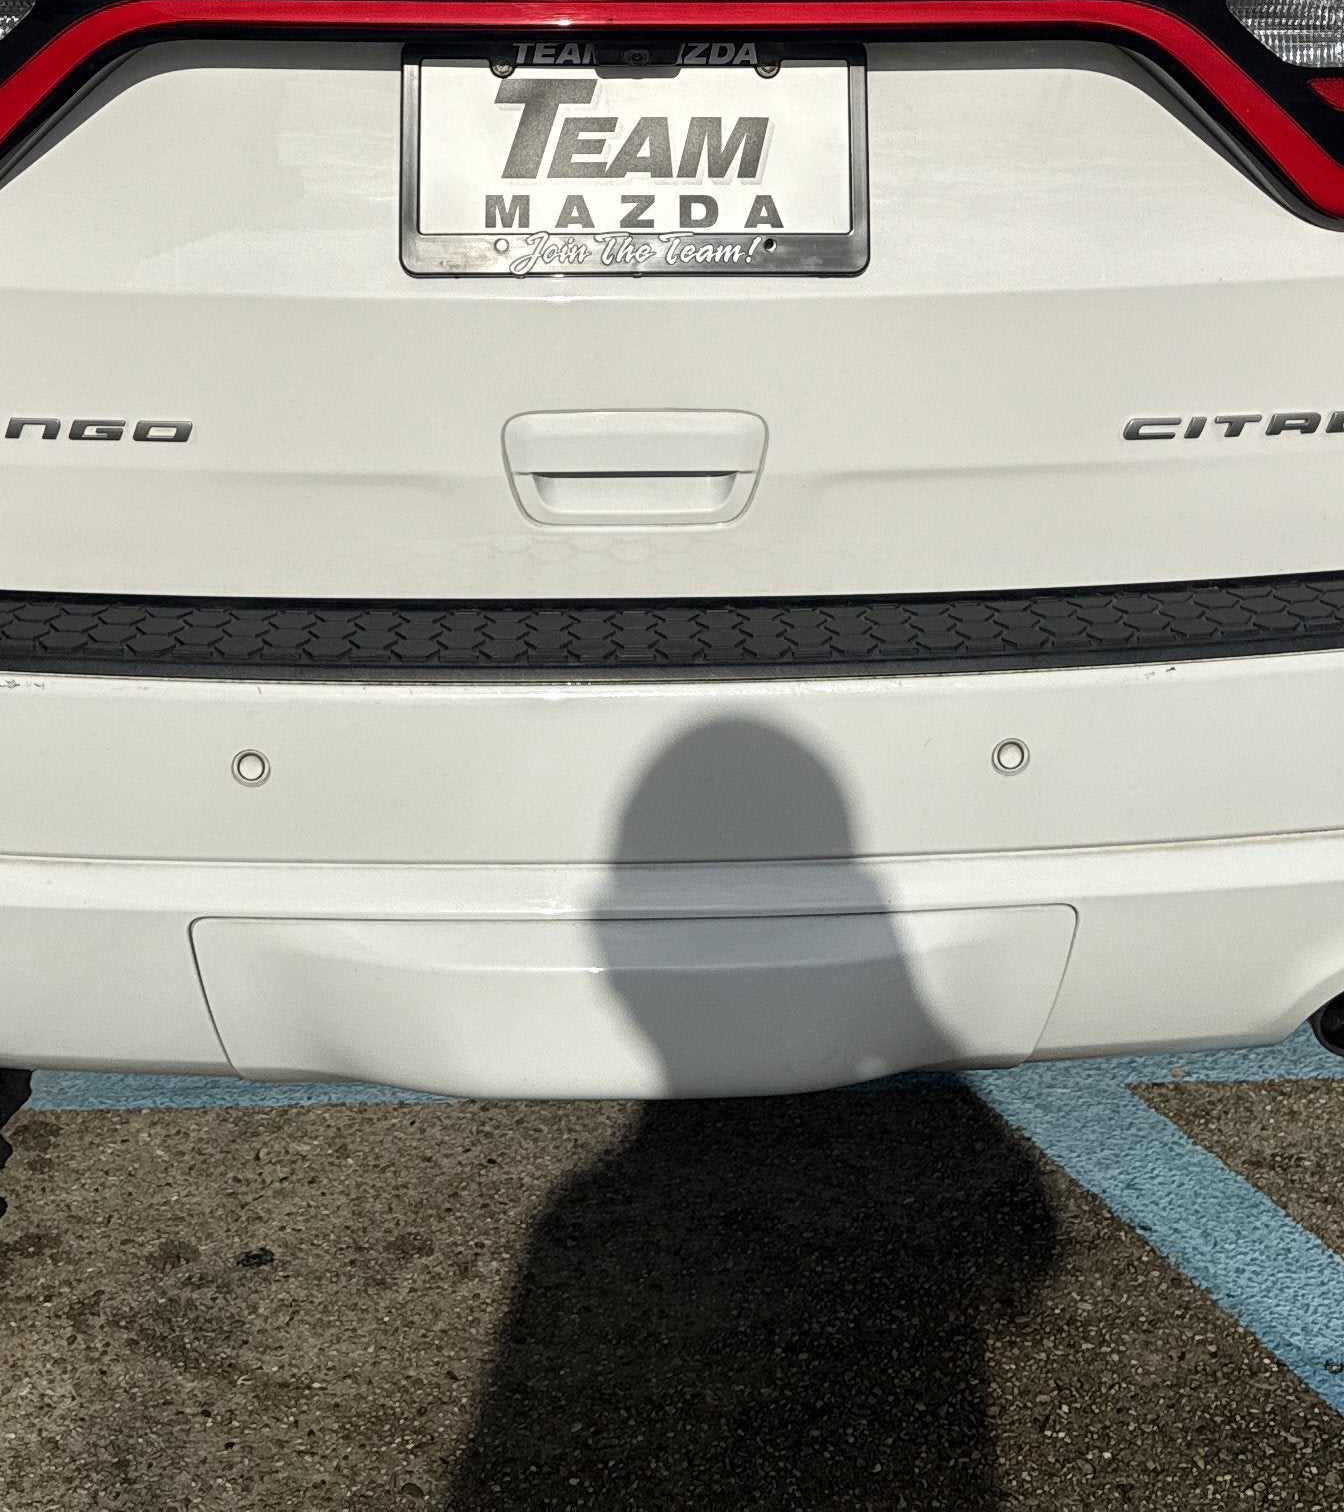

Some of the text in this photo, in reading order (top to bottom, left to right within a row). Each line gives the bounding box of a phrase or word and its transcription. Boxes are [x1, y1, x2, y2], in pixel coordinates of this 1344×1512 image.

[494, 78, 772, 183] TEAM
[484, 194, 784, 228] MAZDA
[509, 231, 763, 275] Join The Team!
